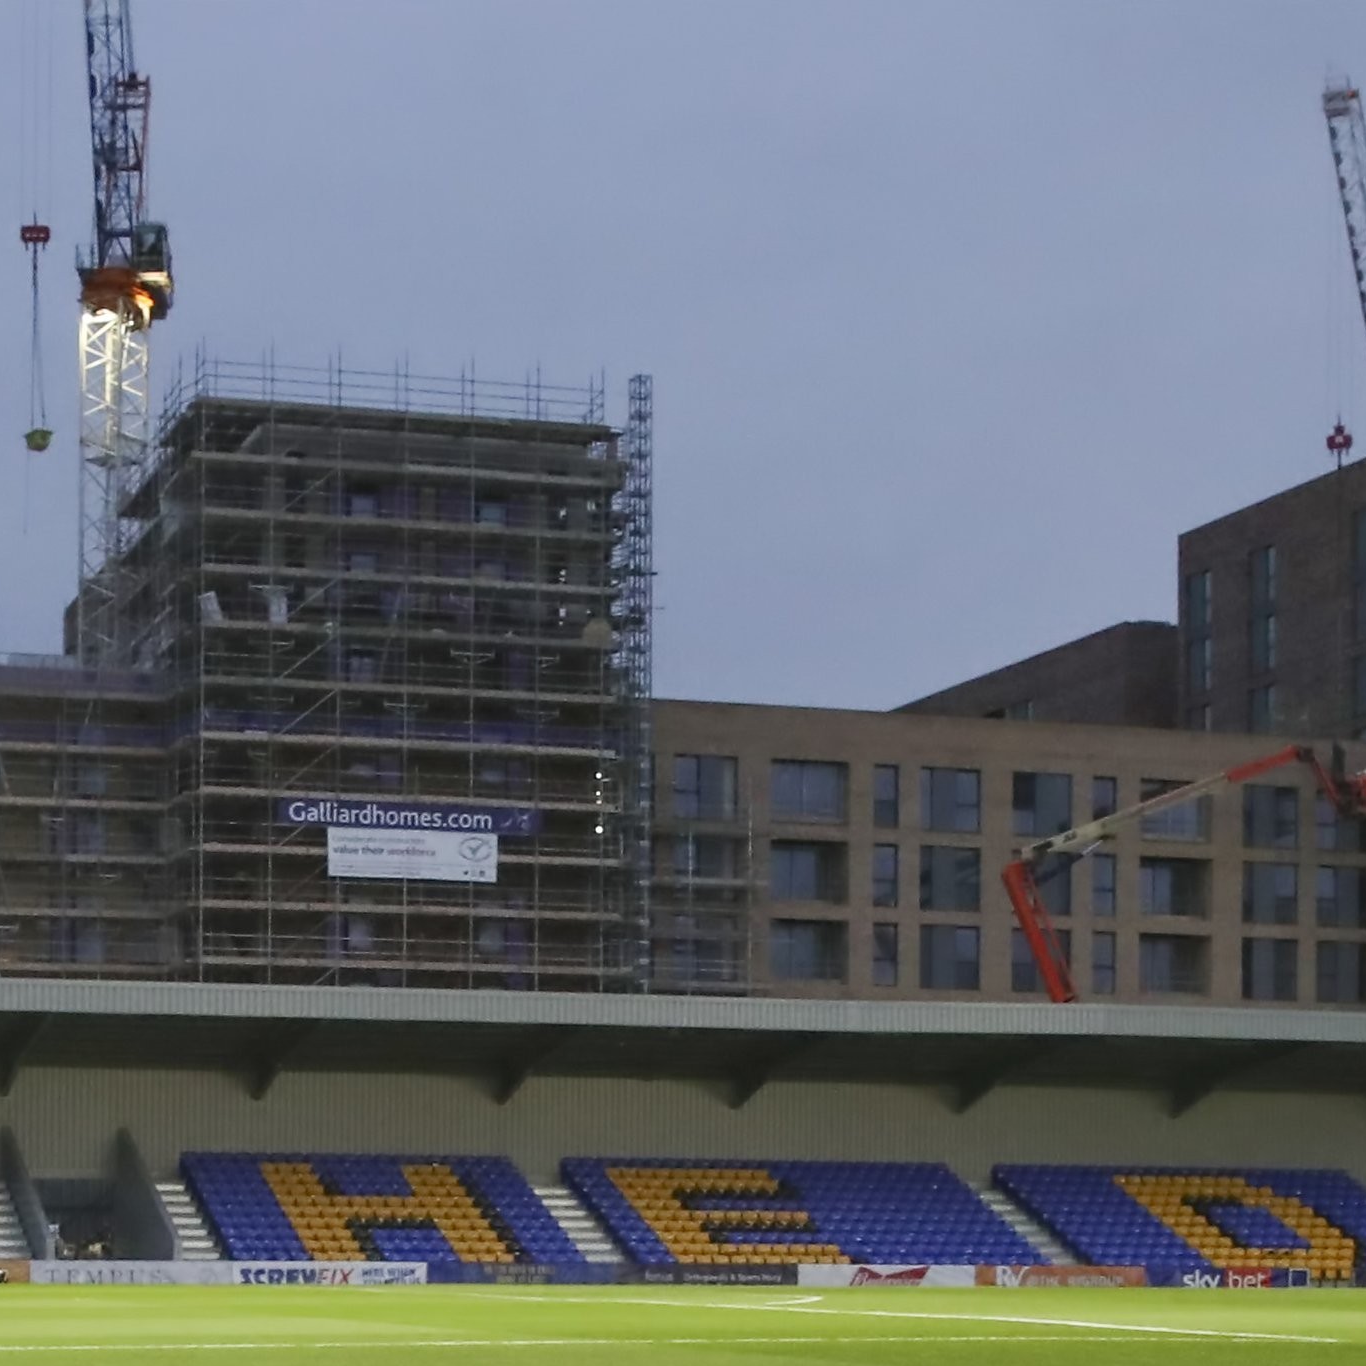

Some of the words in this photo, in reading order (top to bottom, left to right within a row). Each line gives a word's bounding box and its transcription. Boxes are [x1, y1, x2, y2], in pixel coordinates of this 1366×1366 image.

[288, 801, 493, 830] Galliardhomes.com
[240, 1267, 354, 1285] SCREWFIX
[1183, 1269, 1221, 1288] sky
[1228, 1272, 1267, 1288] bet
